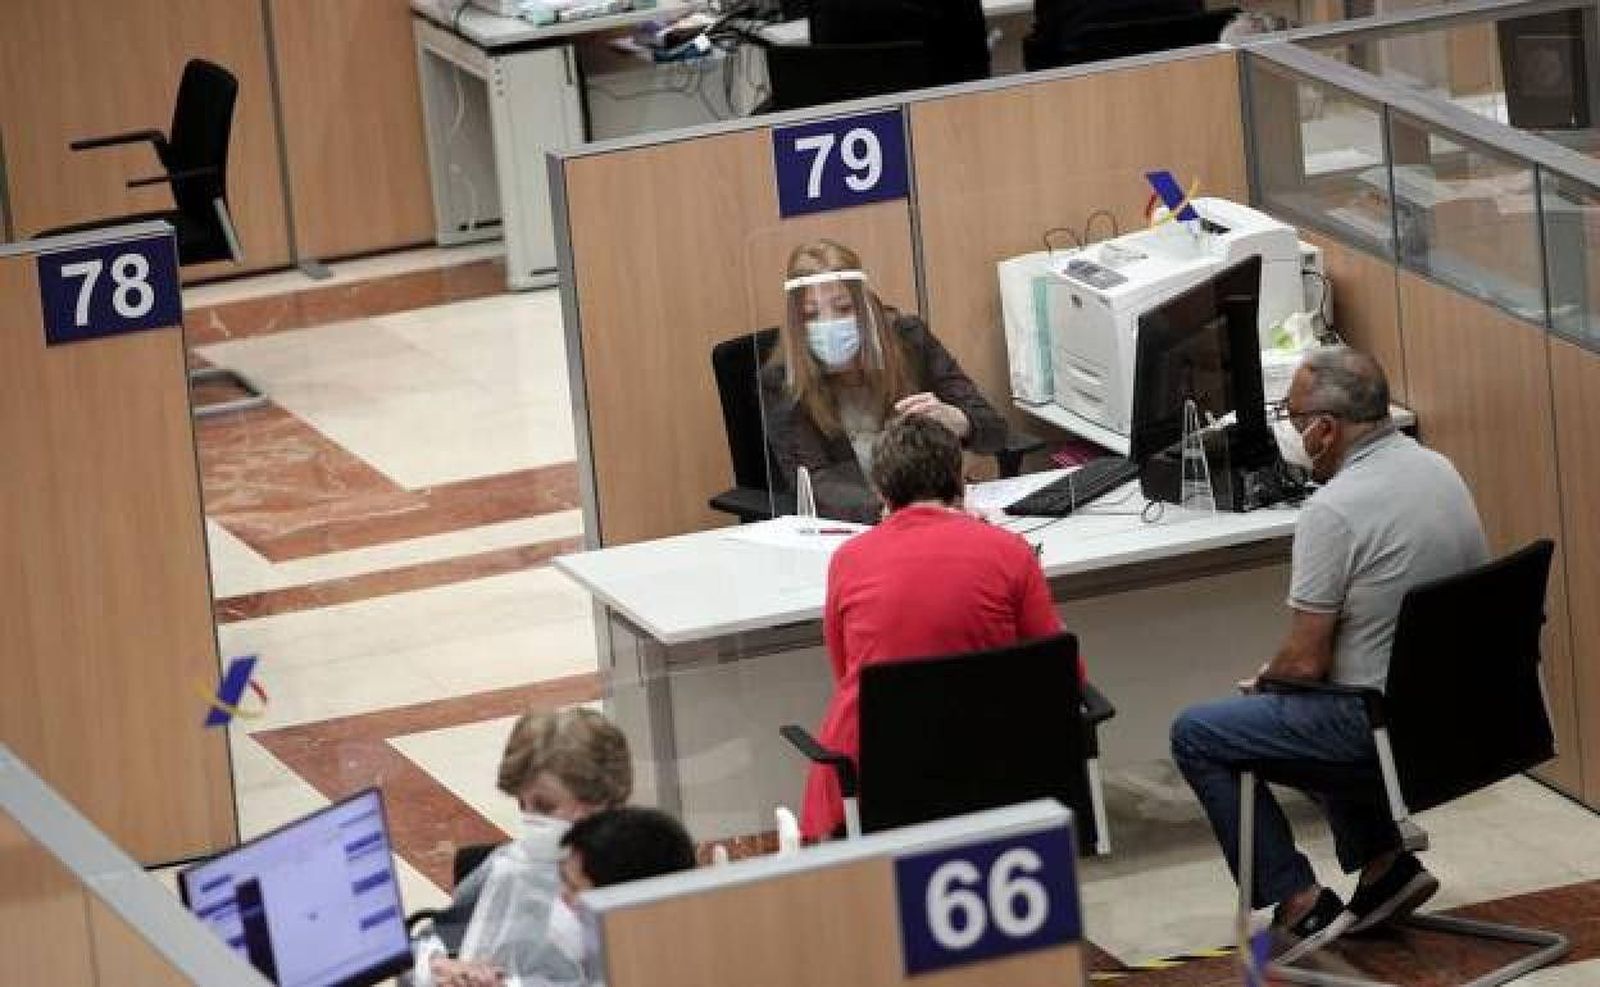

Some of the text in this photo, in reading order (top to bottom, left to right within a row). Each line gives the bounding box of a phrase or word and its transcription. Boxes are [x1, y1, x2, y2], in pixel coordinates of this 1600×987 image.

[794, 127, 883, 199] 79
[60, 253, 155, 327] 78
[926, 847, 1049, 950] 66
